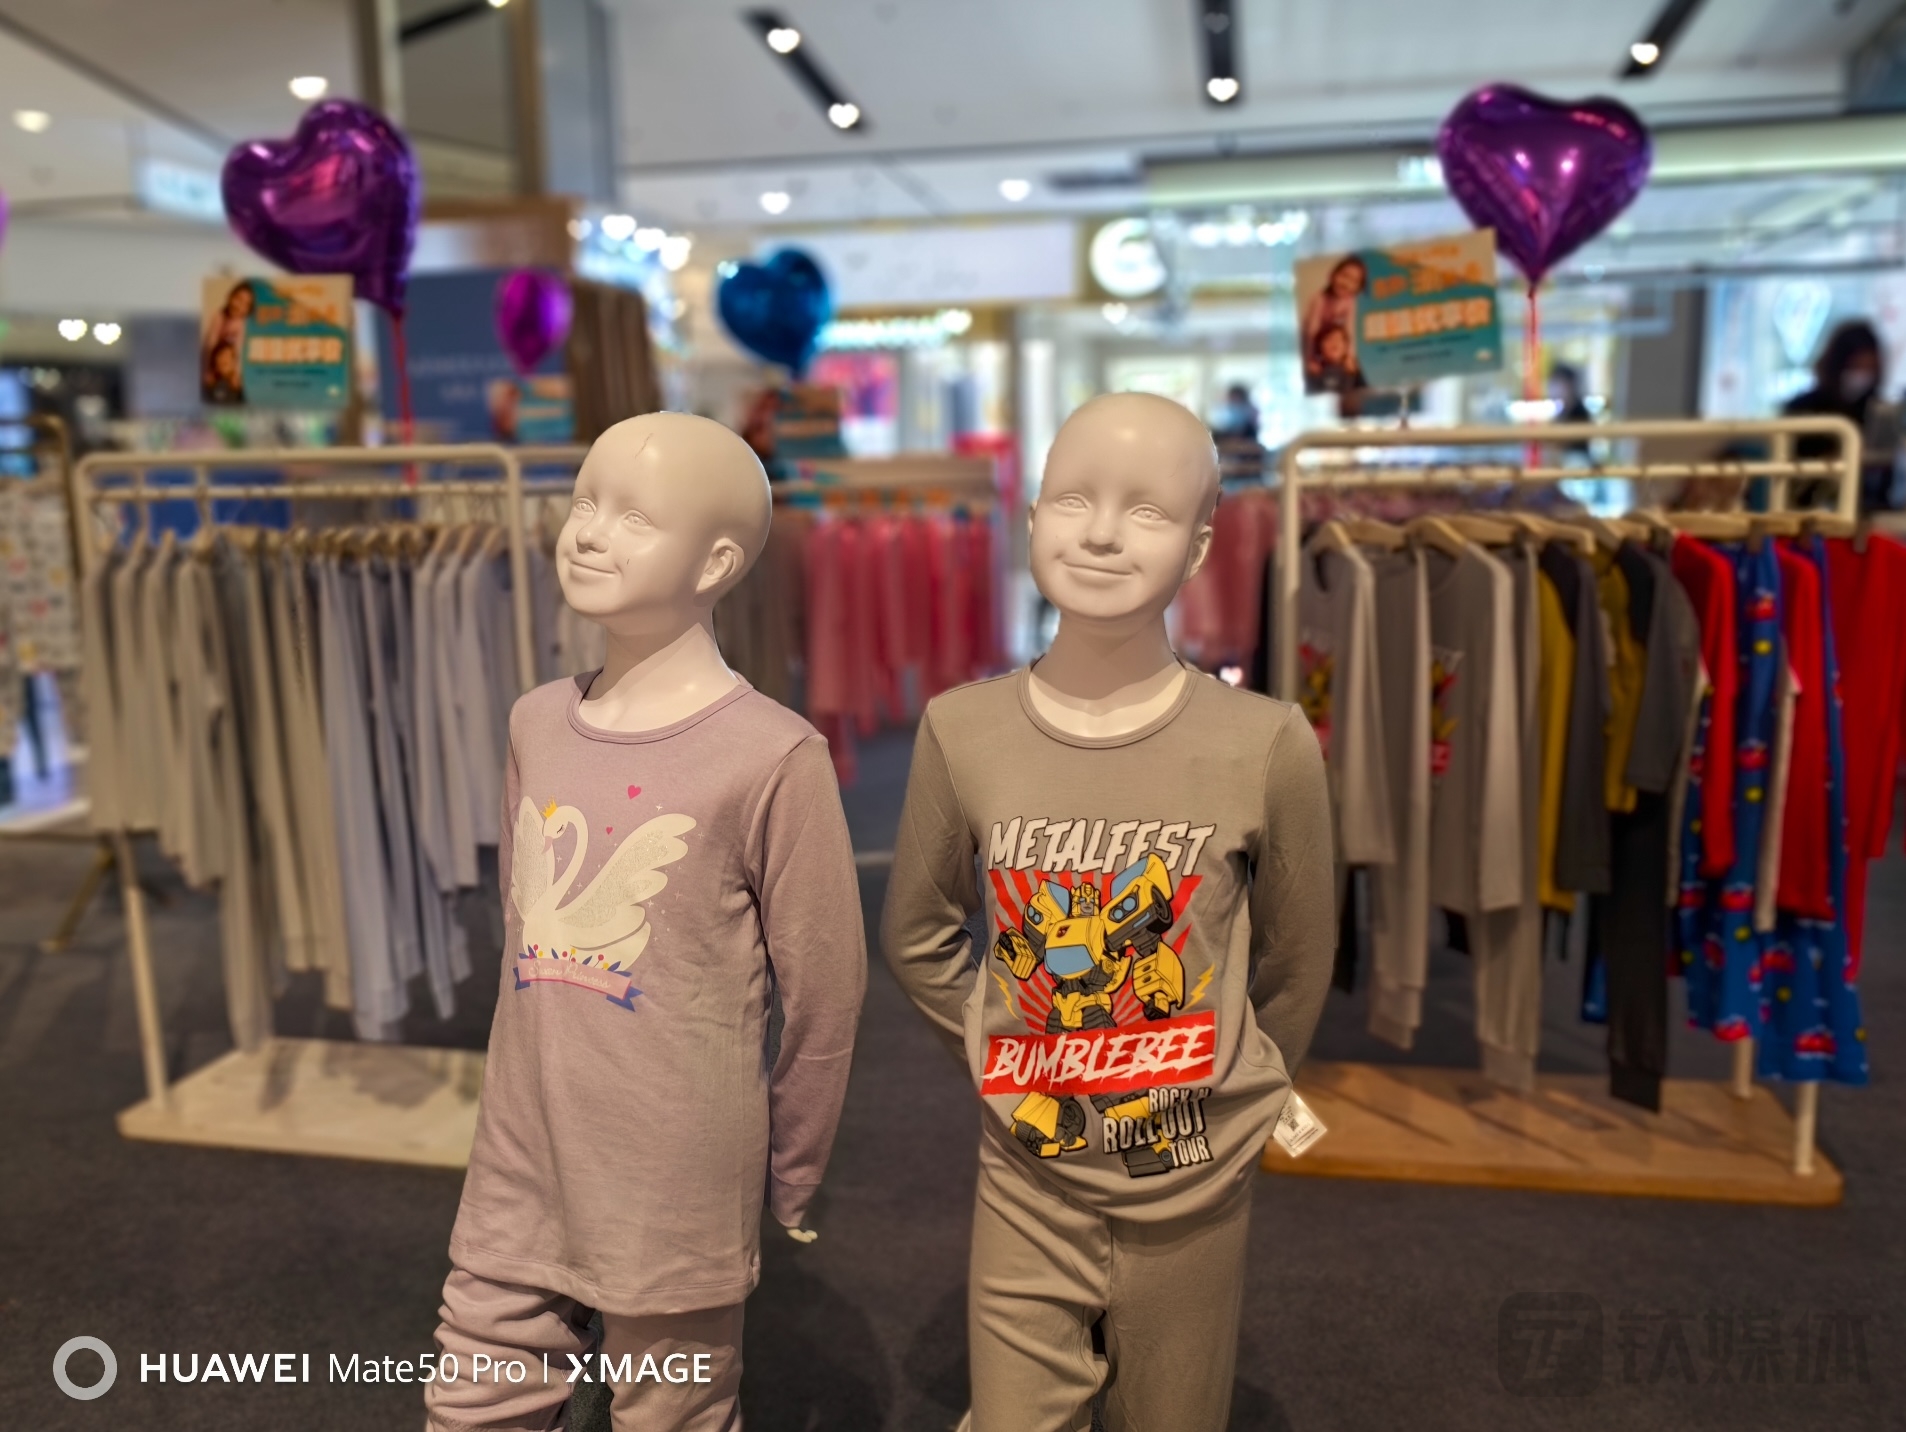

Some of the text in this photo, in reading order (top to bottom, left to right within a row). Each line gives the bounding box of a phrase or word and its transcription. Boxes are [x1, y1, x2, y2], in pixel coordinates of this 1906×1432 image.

[988, 816, 1217, 876] METALFEST
[980, 1024, 1216, 1086] BUMBLEBEE
[1148, 1087, 1192, 1114] ROCK
[1168, 1135, 1214, 1169] TOUR
